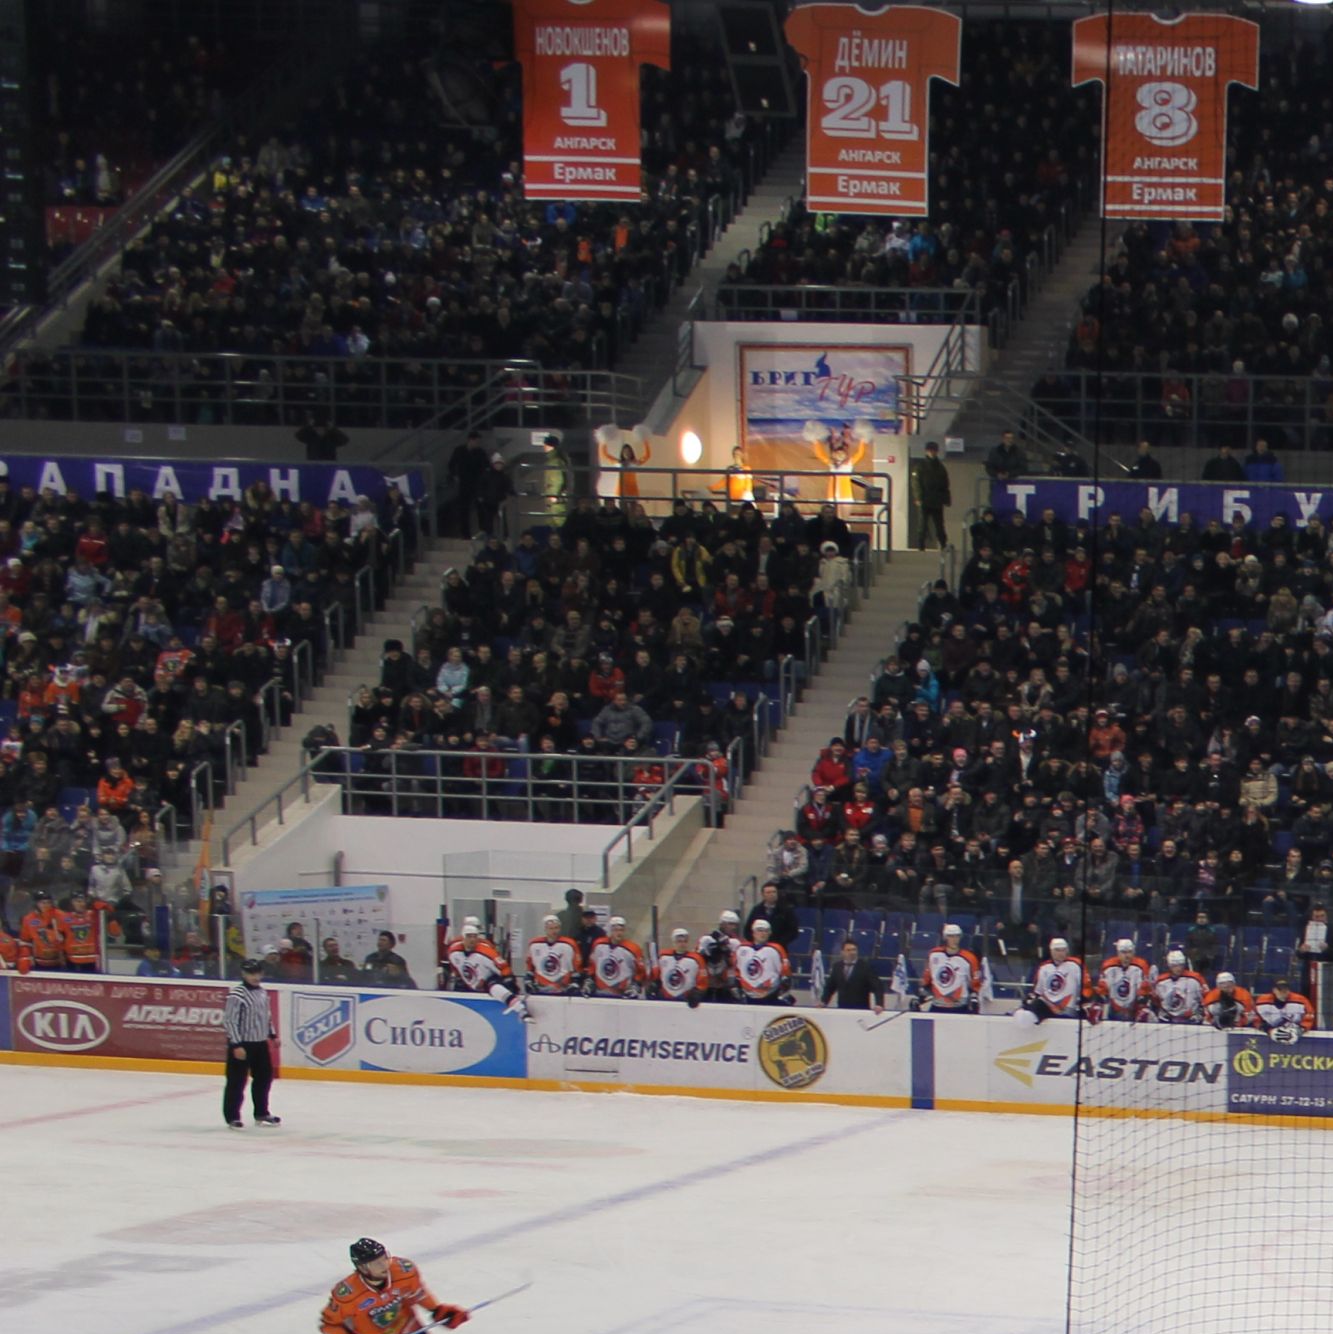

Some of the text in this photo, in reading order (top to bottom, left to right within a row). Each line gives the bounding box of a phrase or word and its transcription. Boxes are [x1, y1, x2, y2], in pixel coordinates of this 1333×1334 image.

[834, 30, 908, 73] ДЁМИН
[1116, 45, 1216, 76] ТАТАРИНОВ
[560, 63, 607, 127] 1
[821, 76, 919, 140] 21
[1135, 82, 1198, 147] 8
[553, 136, 616, 150] АНГАРСК
[838, 149, 901, 164] АНГАРСК
[553, 163, 617, 182] Ермак
[1133, 157, 1198, 171] АНГАРСК
[837, 176, 901, 196] Ермак
[1131, 184, 1197, 204] Ермак
[750, 370, 817, 387] БРИГ
[32, 1011, 97, 1040] KIA
[302, 1009, 344, 1044] ВХЛ
[364, 1017, 465, 1049] Сибна
[1035, 1054, 1223, 1084] EASTON
[1231, 1092, 1277, 1105] САТУРН
